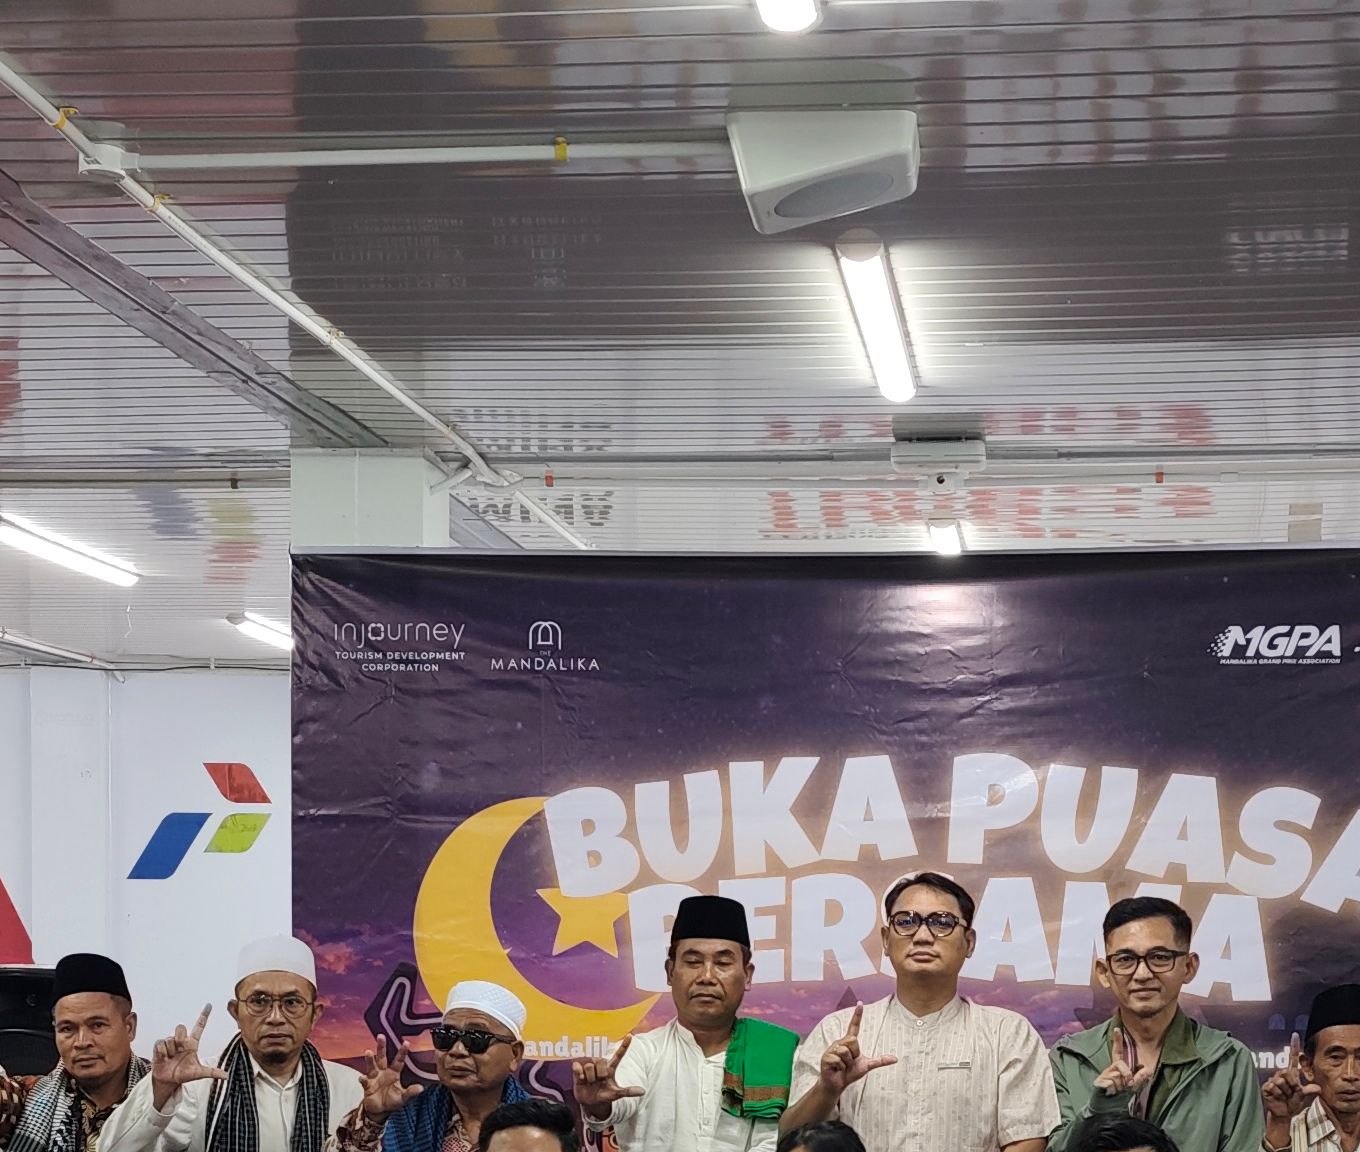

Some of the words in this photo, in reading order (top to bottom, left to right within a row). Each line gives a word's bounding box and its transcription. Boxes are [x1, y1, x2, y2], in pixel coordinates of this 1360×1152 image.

[334, 622, 466, 649] injourney
[1224, 625, 1341, 657] MGPA
[335, 651, 382, 660] TOURISM
[386, 651, 466, 660] DEVELOPMENT
[361, 663, 440, 672] CORPORATION
[490, 658, 600, 671] MANDALIKA
[544, 754, 918, 898] BUKA
[627, 871, 1273, 1001] BERAMA
